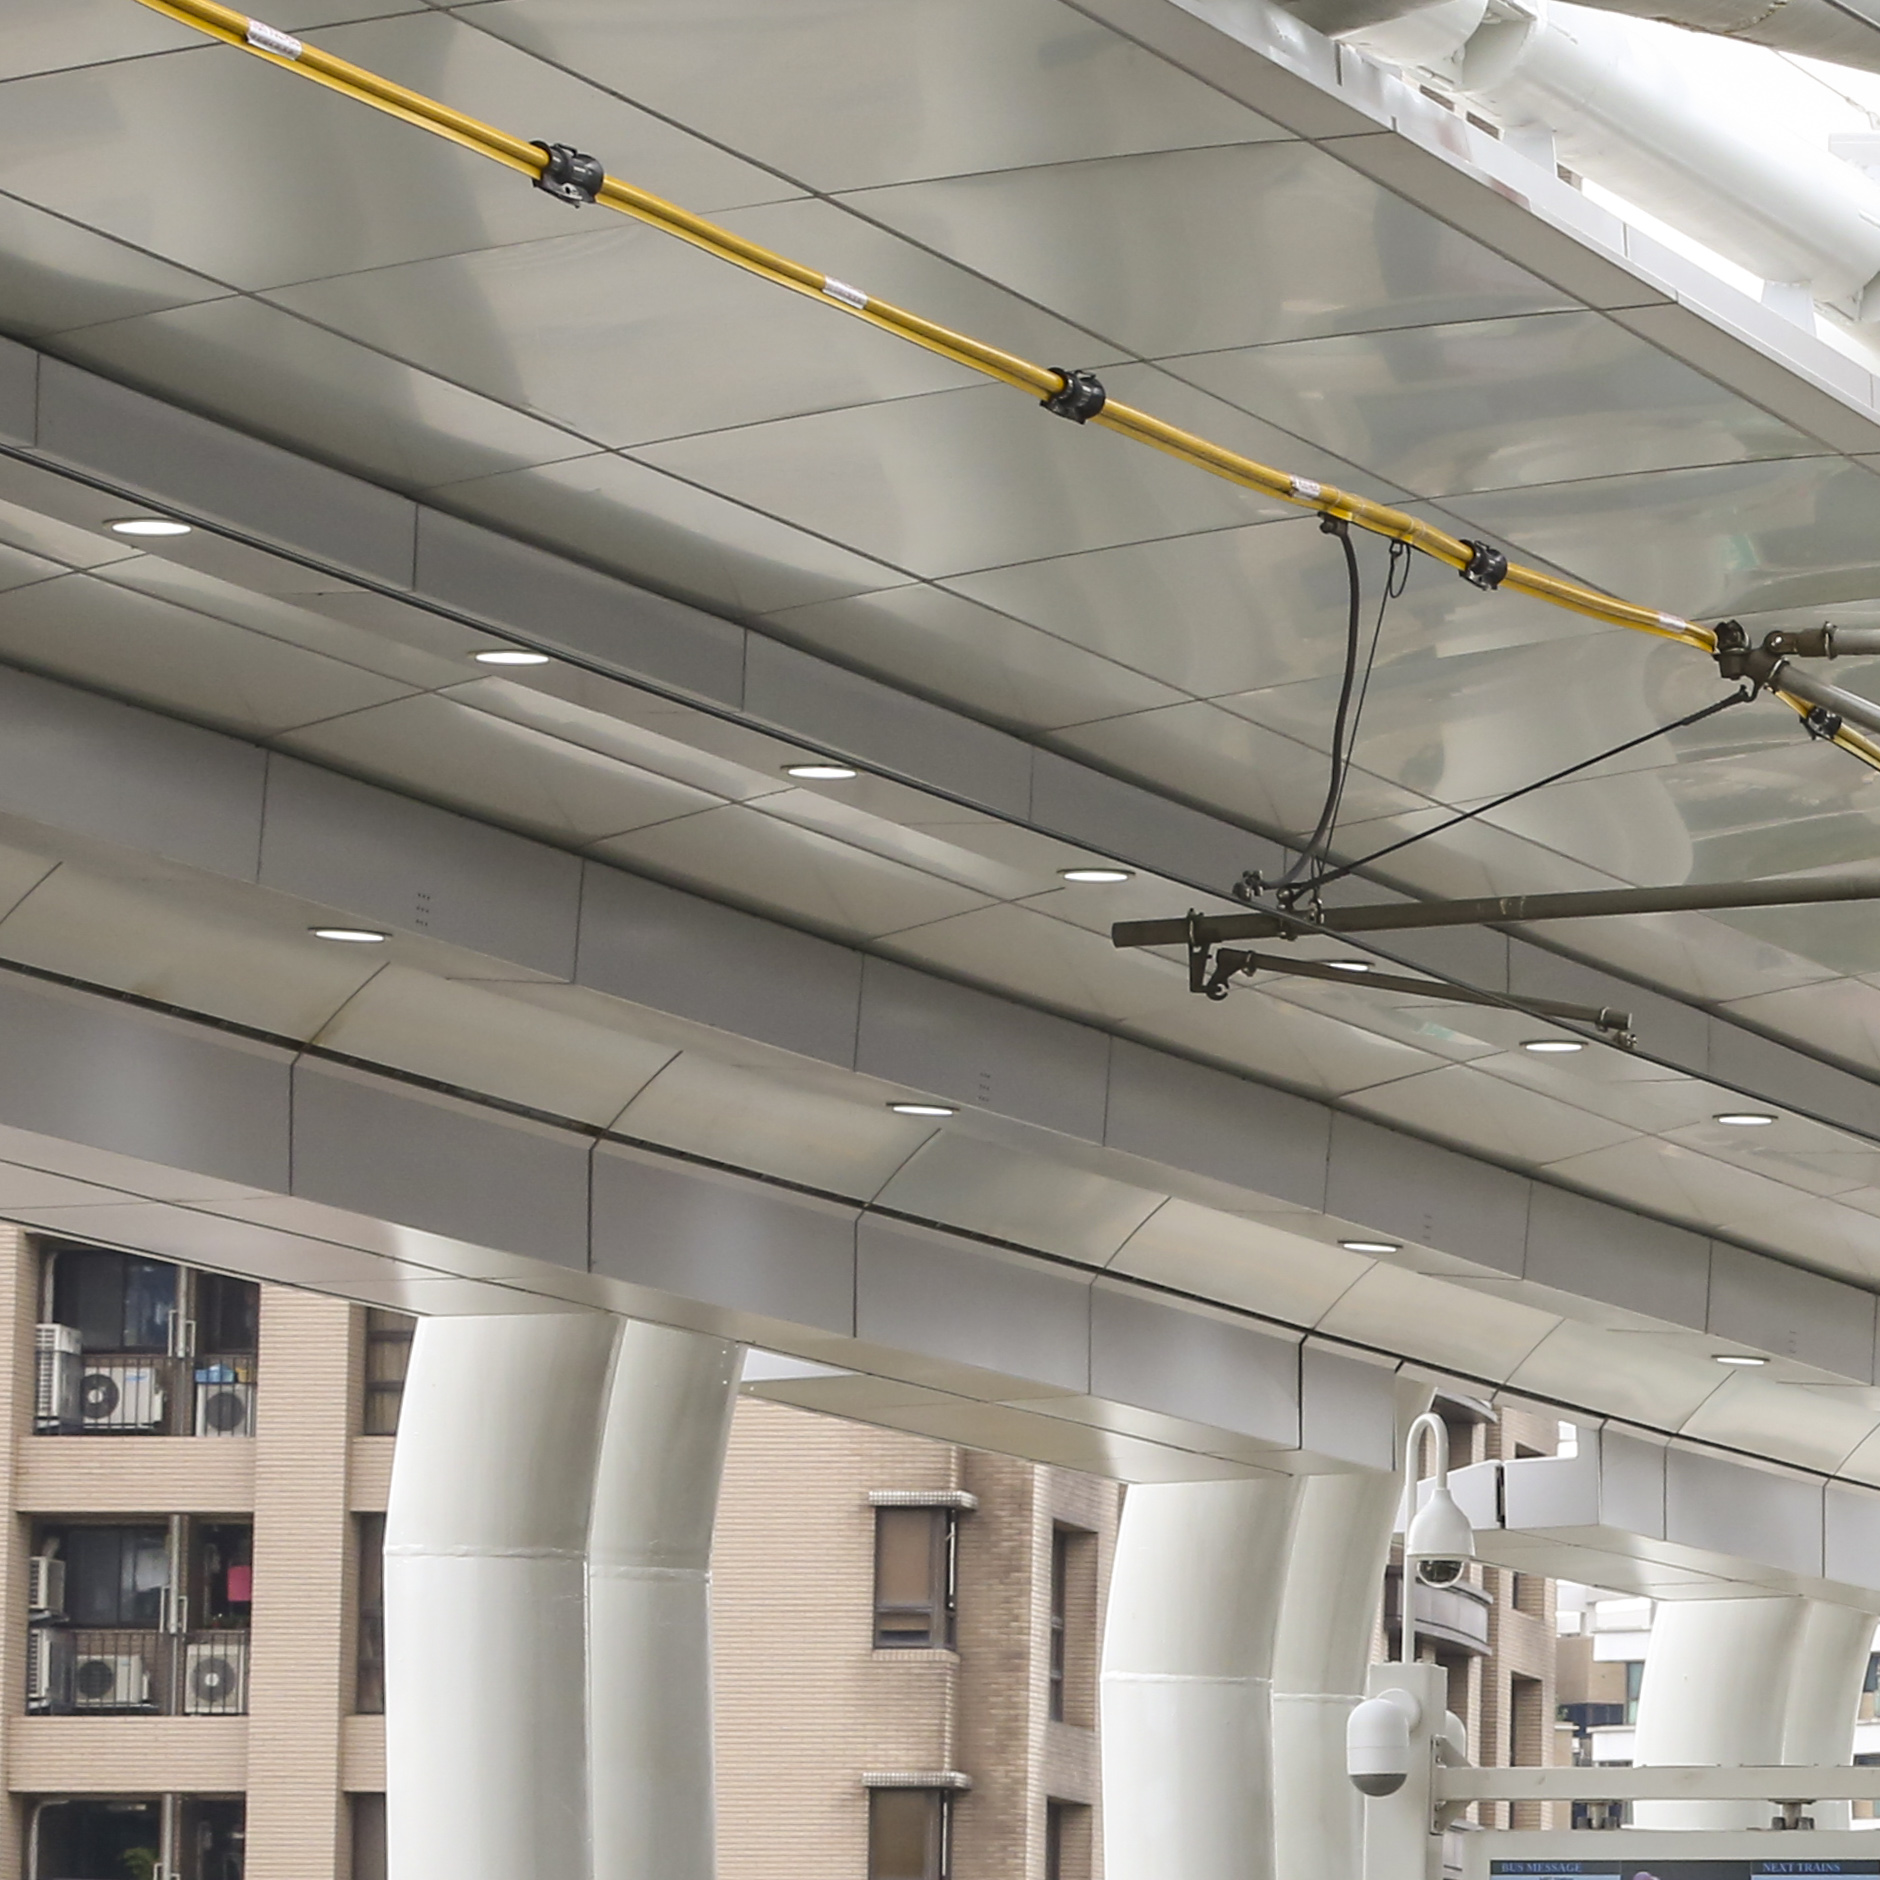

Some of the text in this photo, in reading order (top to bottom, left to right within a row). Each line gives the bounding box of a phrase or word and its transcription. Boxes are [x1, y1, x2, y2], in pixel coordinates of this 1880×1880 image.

[1501, 1862, 1583, 1872] BUS MESSAGE
[1763, 1862, 1841, 1872] NEXT TRAINS
